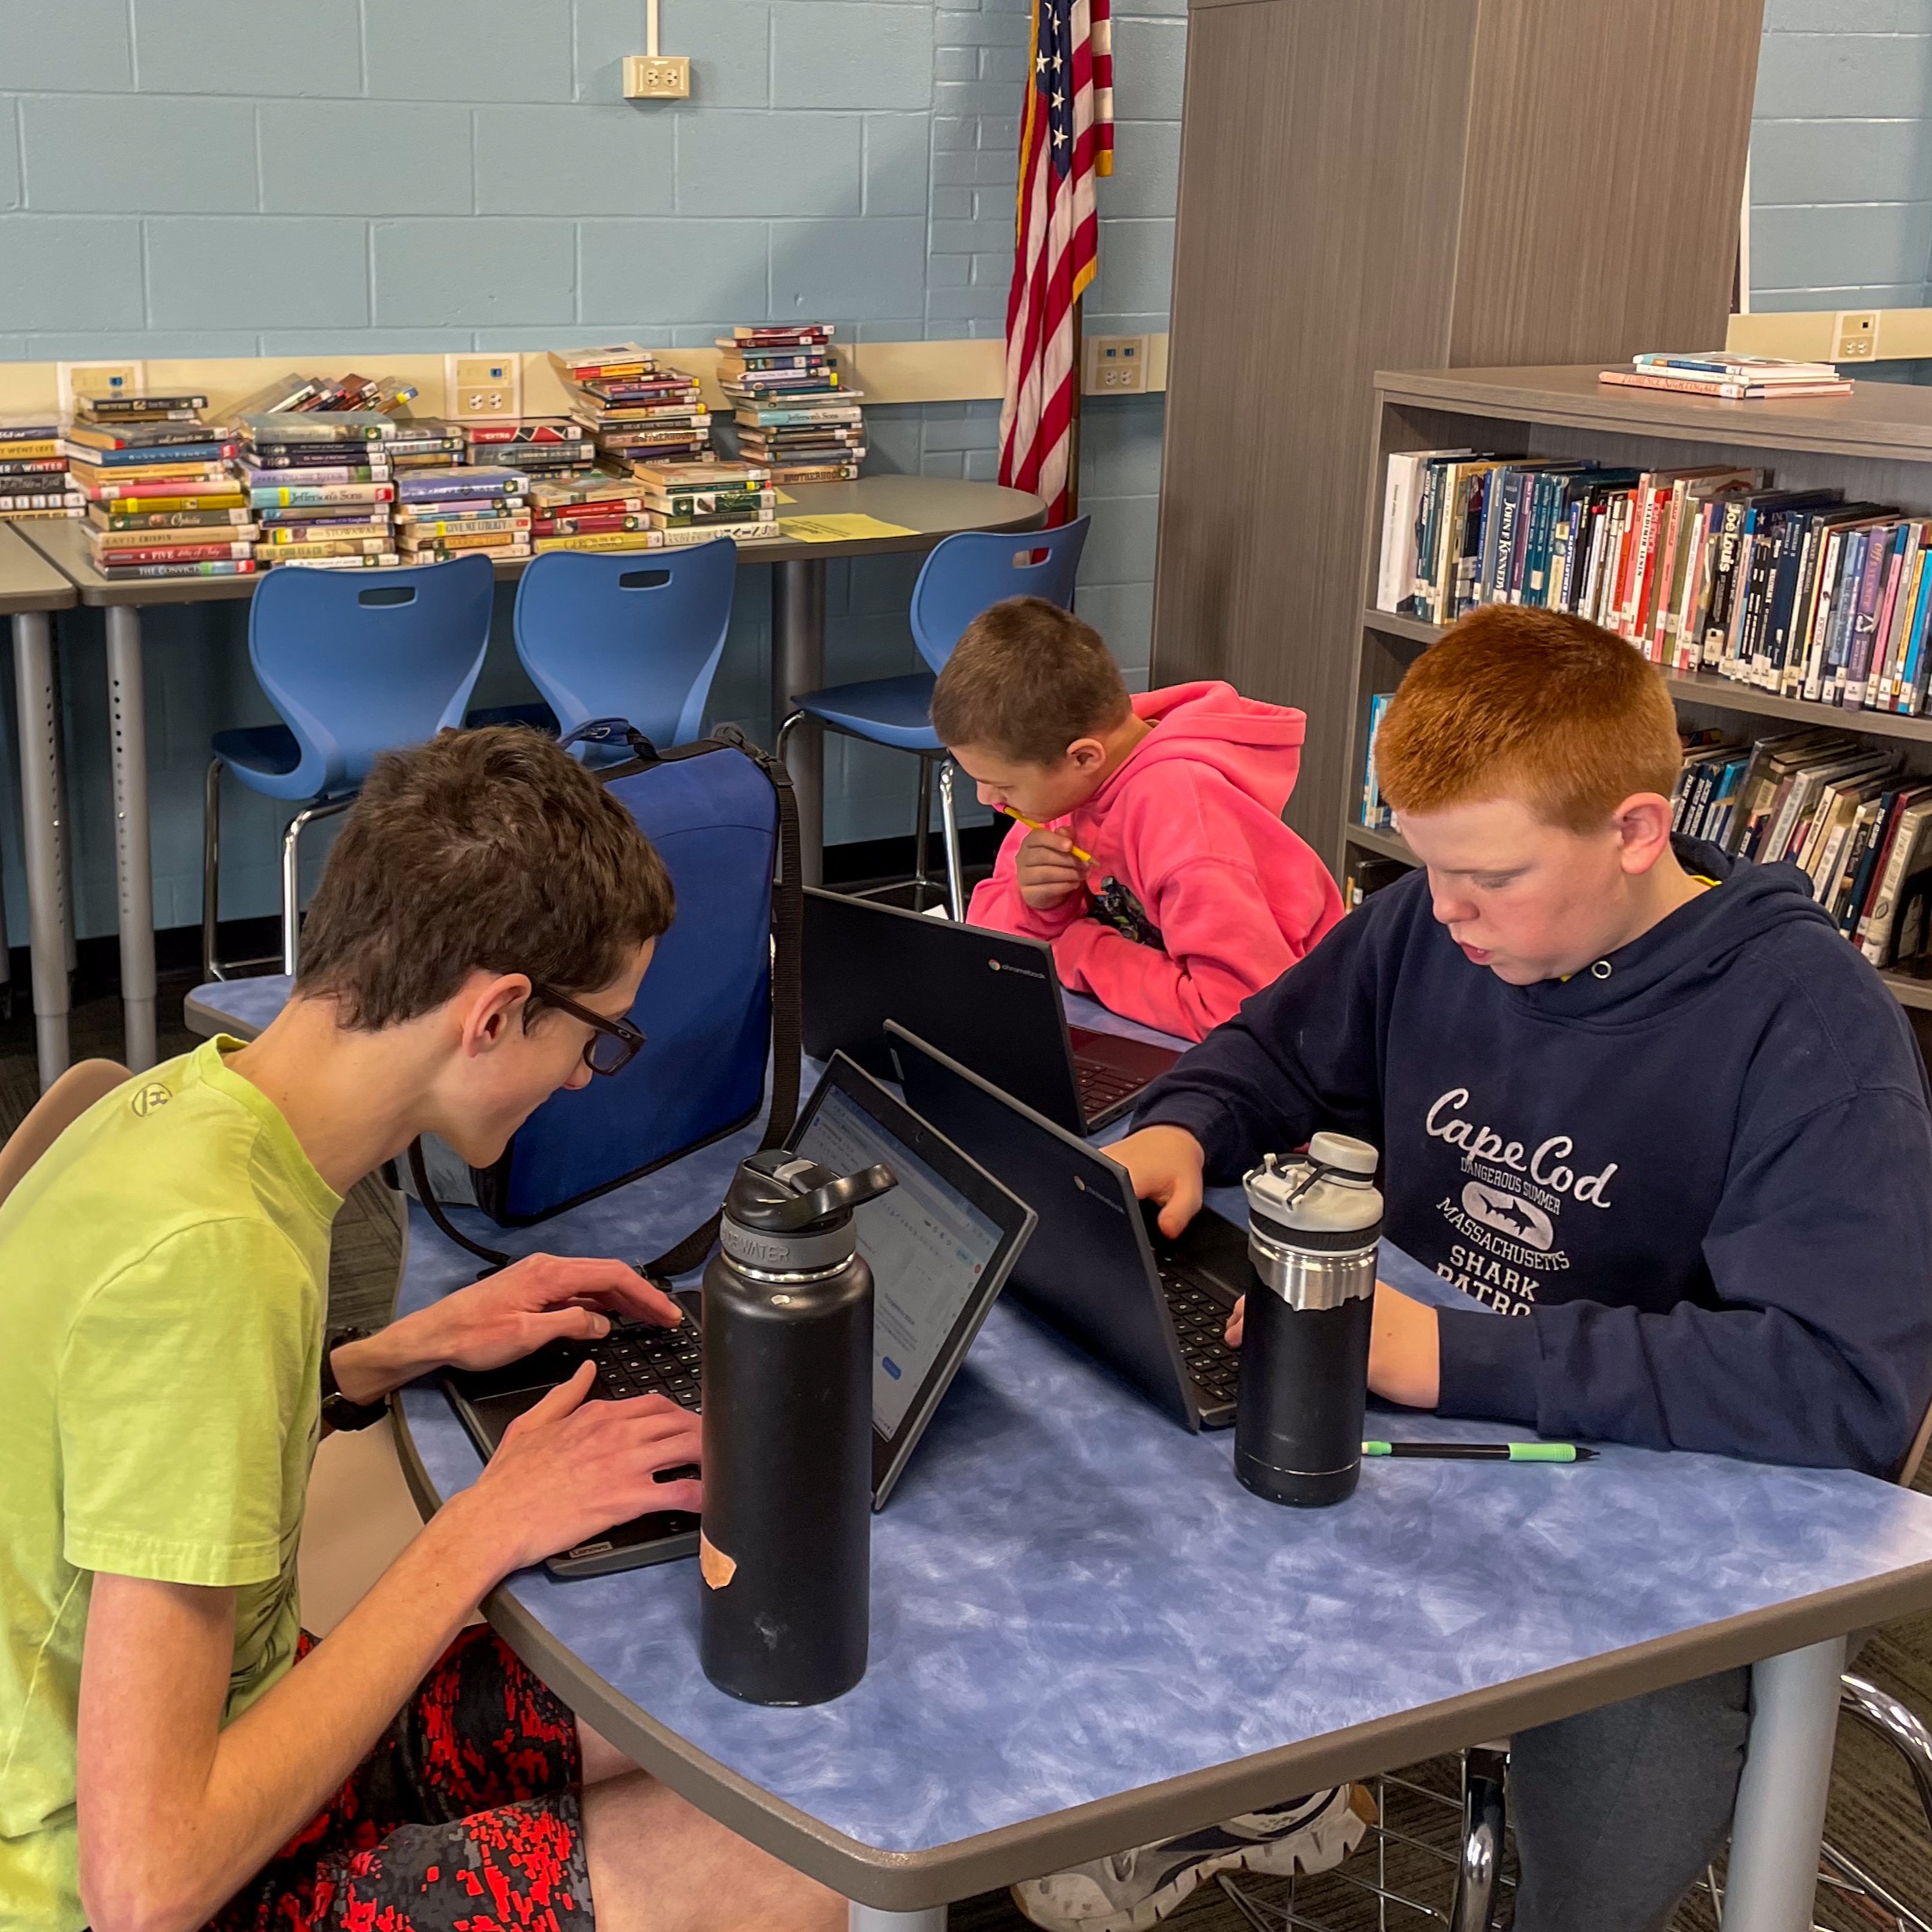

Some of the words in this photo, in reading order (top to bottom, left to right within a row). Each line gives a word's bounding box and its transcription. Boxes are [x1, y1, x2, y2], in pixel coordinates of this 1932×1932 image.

[1623, 374, 1660, 387] FLORENCE
[1664, 378, 1719, 393] NIGHTINGALE
[8, 446, 33, 454] WENT
[22, 461, 63, 472] WINTER
[784, 471, 839, 483] BROTHERHOO
[290, 491, 338, 504] Jefferson's
[340, 490, 363, 499] Sons
[1500, 498, 1515, 530] JOHN
[1724, 505, 1742, 534] Joe
[325, 526, 377, 538] STOWAWAY
[446, 523, 465, 534] GIVE
[466, 522, 476, 530] ME
[478, 520, 506, 530] LIBERTY
[1642, 502, 1651, 546] VLADIMIR
[564, 536, 624, 549] GERONIMO
[1868, 542, 1883, 561] Off
[151, 549, 173, 560] FIVE
[1719, 532, 1737, 573] Louis
[139, 567, 156, 575] THE
[1493, 538, 1508, 590] KENNEDY
[1861, 560, 1878, 607] BALANCE
[1815, 616, 1824, 646] KRYSIA
[1426, 1088, 1527, 1172] Cape
[1530, 1136, 1619, 1208] Cod
[1460, 1157, 1522, 1194] DANGEROUS
[1522, 1182, 1561, 1216] SUMMER
[1435, 1197, 1570, 1271] MASSACHUSETTS
[1449, 1244, 1540, 1303] SHARK
[571, 1543, 609, 1556] Lenovo
